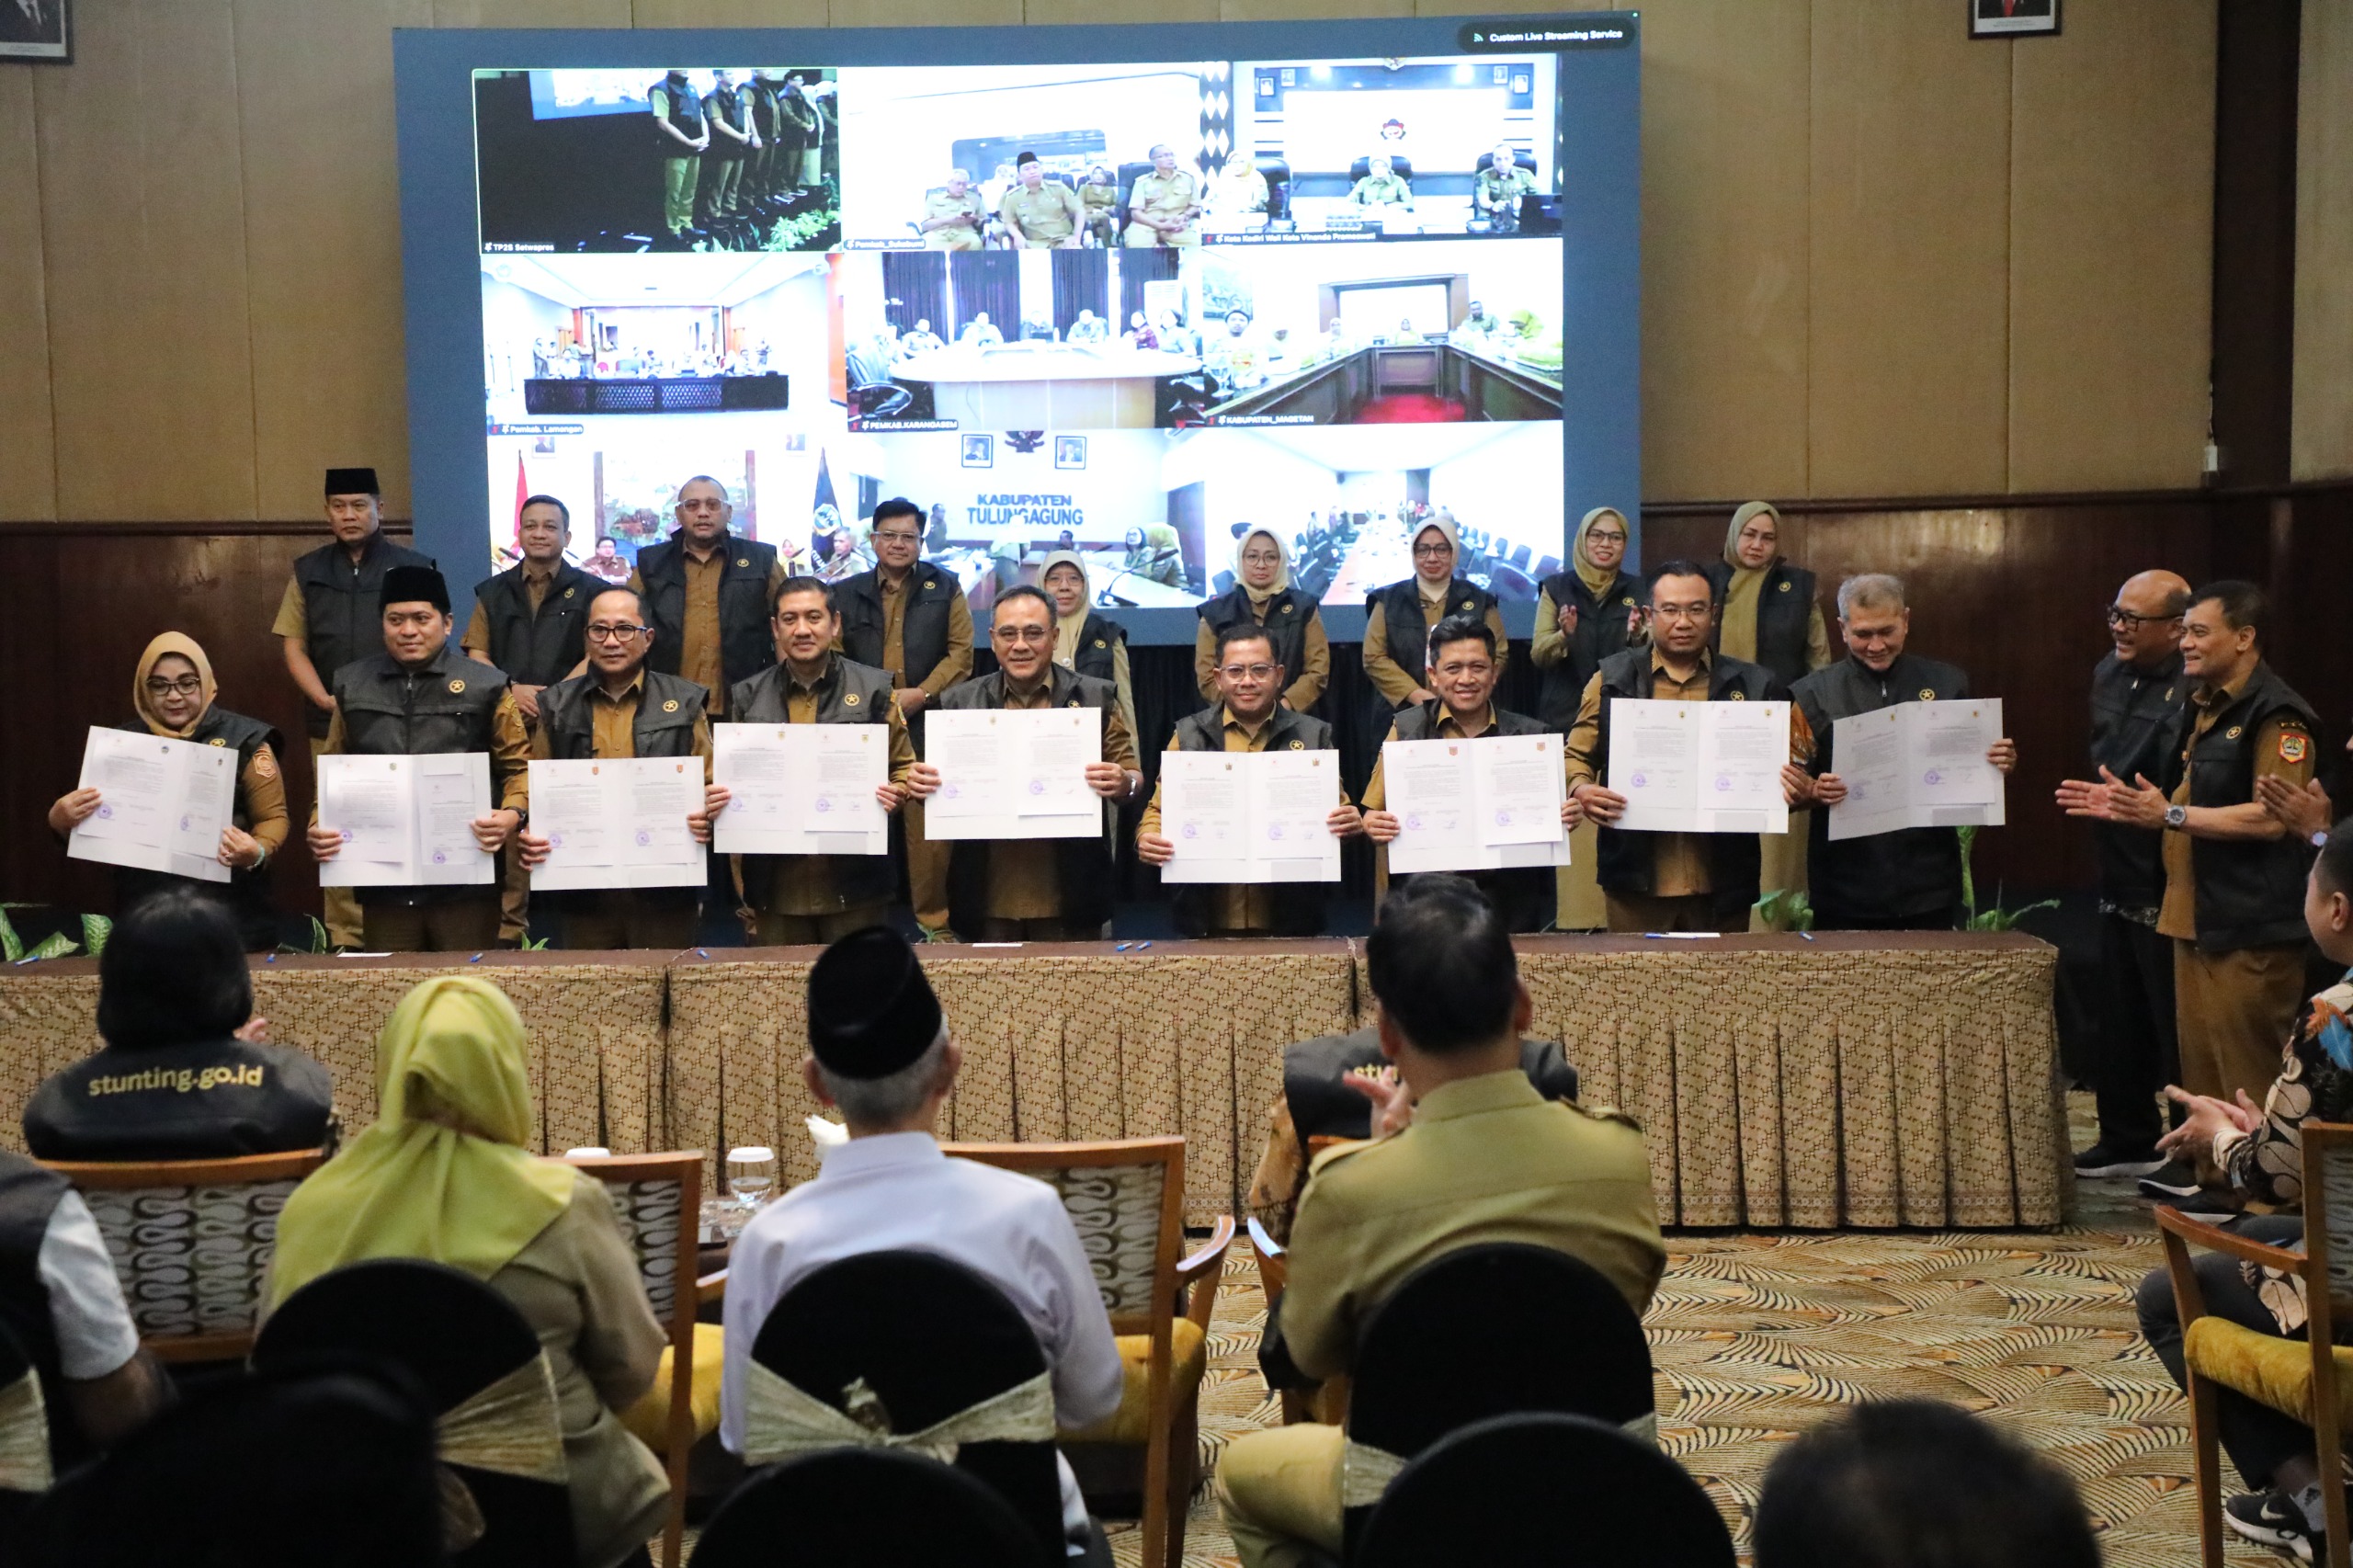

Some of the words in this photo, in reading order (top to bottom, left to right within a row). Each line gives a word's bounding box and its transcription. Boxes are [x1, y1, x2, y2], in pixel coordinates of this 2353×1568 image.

[1489, 33, 1524, 42] Custom
[1525, 32, 1543, 41] Live
[1544, 30, 1588, 41] Streaming
[1589, 29, 1623, 40] Service
[493, 243, 513, 251] TP2S
[977, 494, 1072, 506] KABUPATEN
[88, 1063, 263, 1096] stunting.go.id
